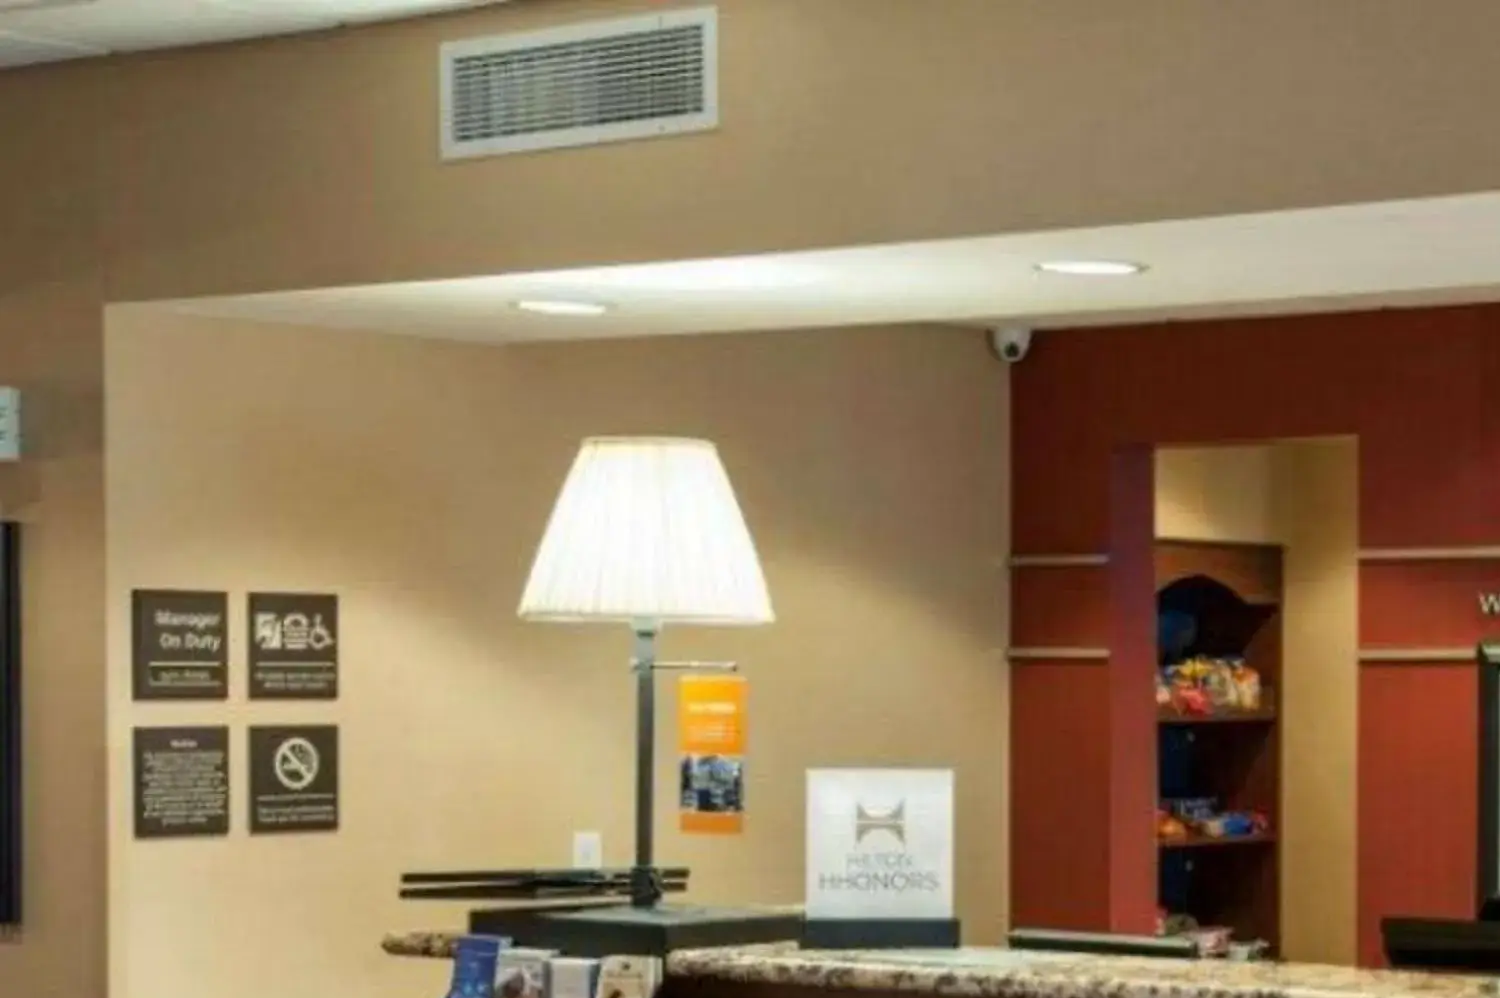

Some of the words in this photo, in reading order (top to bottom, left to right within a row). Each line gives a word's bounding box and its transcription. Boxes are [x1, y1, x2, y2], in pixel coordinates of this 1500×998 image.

[154, 610, 220, 629] Manager
[159, 633, 181, 650] On
[185, 633, 221, 653] Duty
[817, 872, 941, 891] HHONORS
